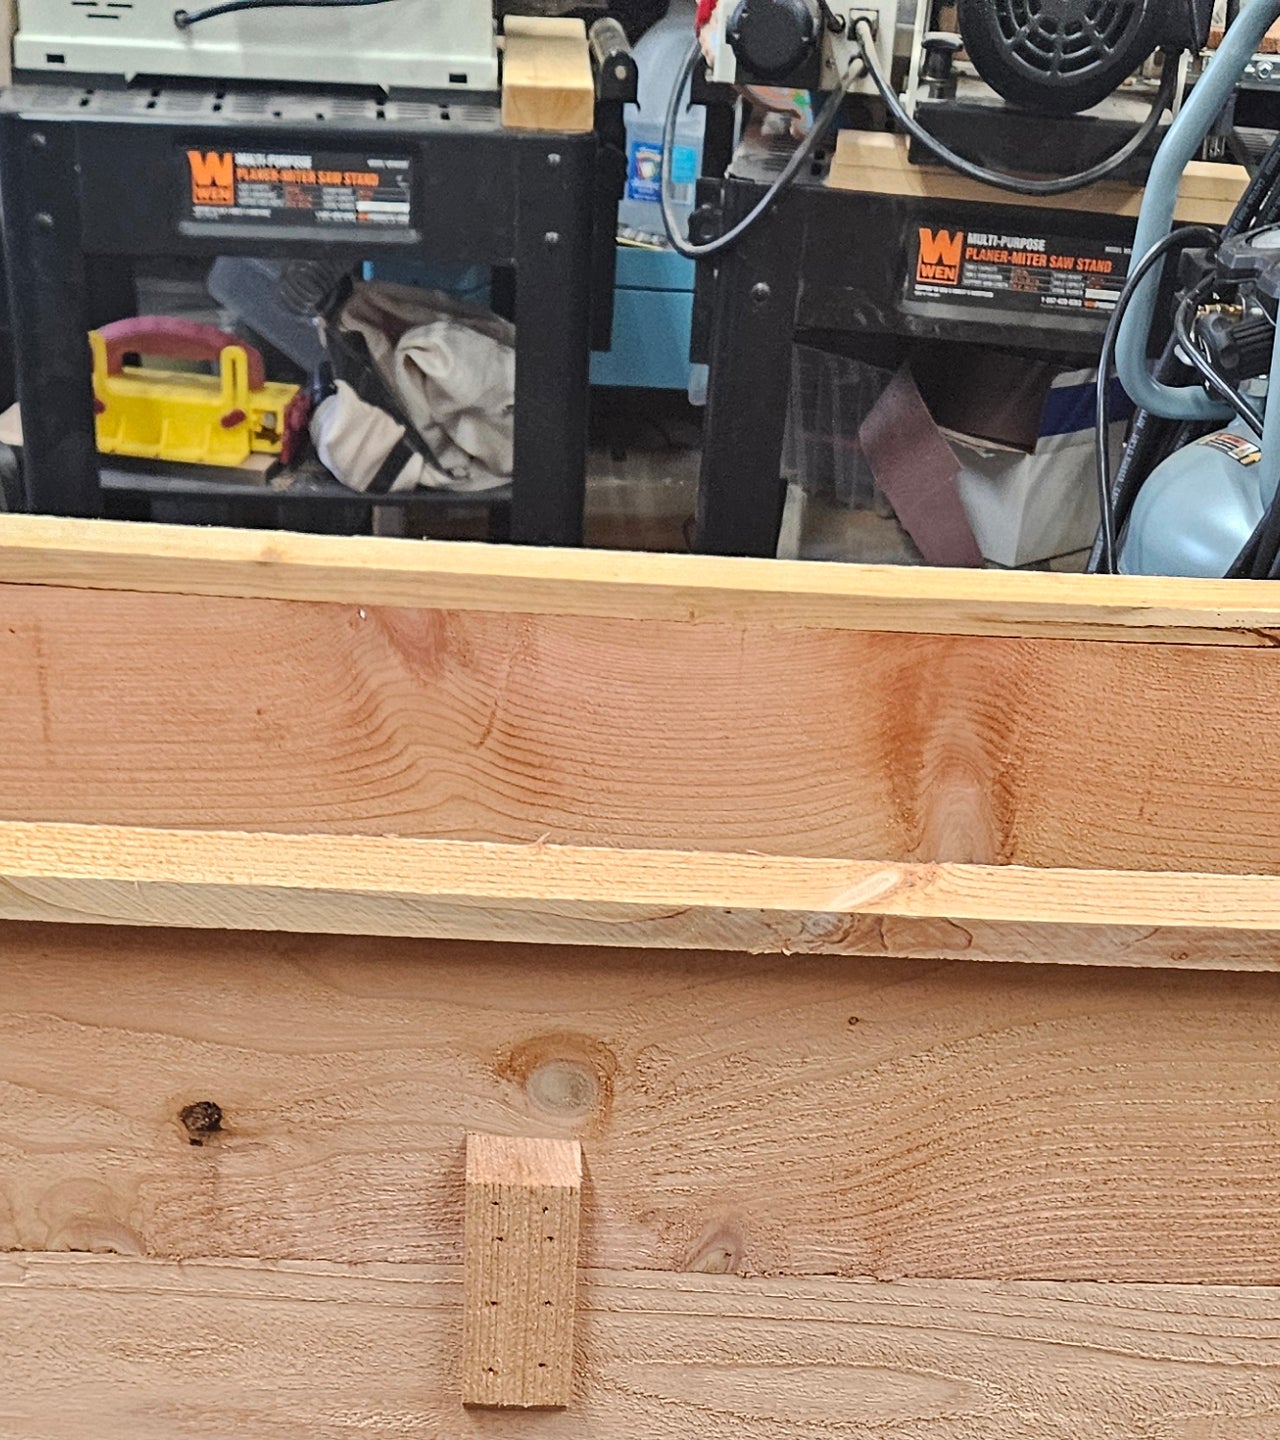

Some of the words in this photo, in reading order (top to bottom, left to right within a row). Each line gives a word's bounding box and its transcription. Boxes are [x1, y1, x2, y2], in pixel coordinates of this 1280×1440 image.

[966, 232, 1046, 251] MULTI-PURPOSE
[965, 247, 1047, 268] PLANER-MITER
[1049, 255, 1074, 270] SAW
[1076, 258, 1113, 274] STAND
[921, 264, 956, 281] WEN
